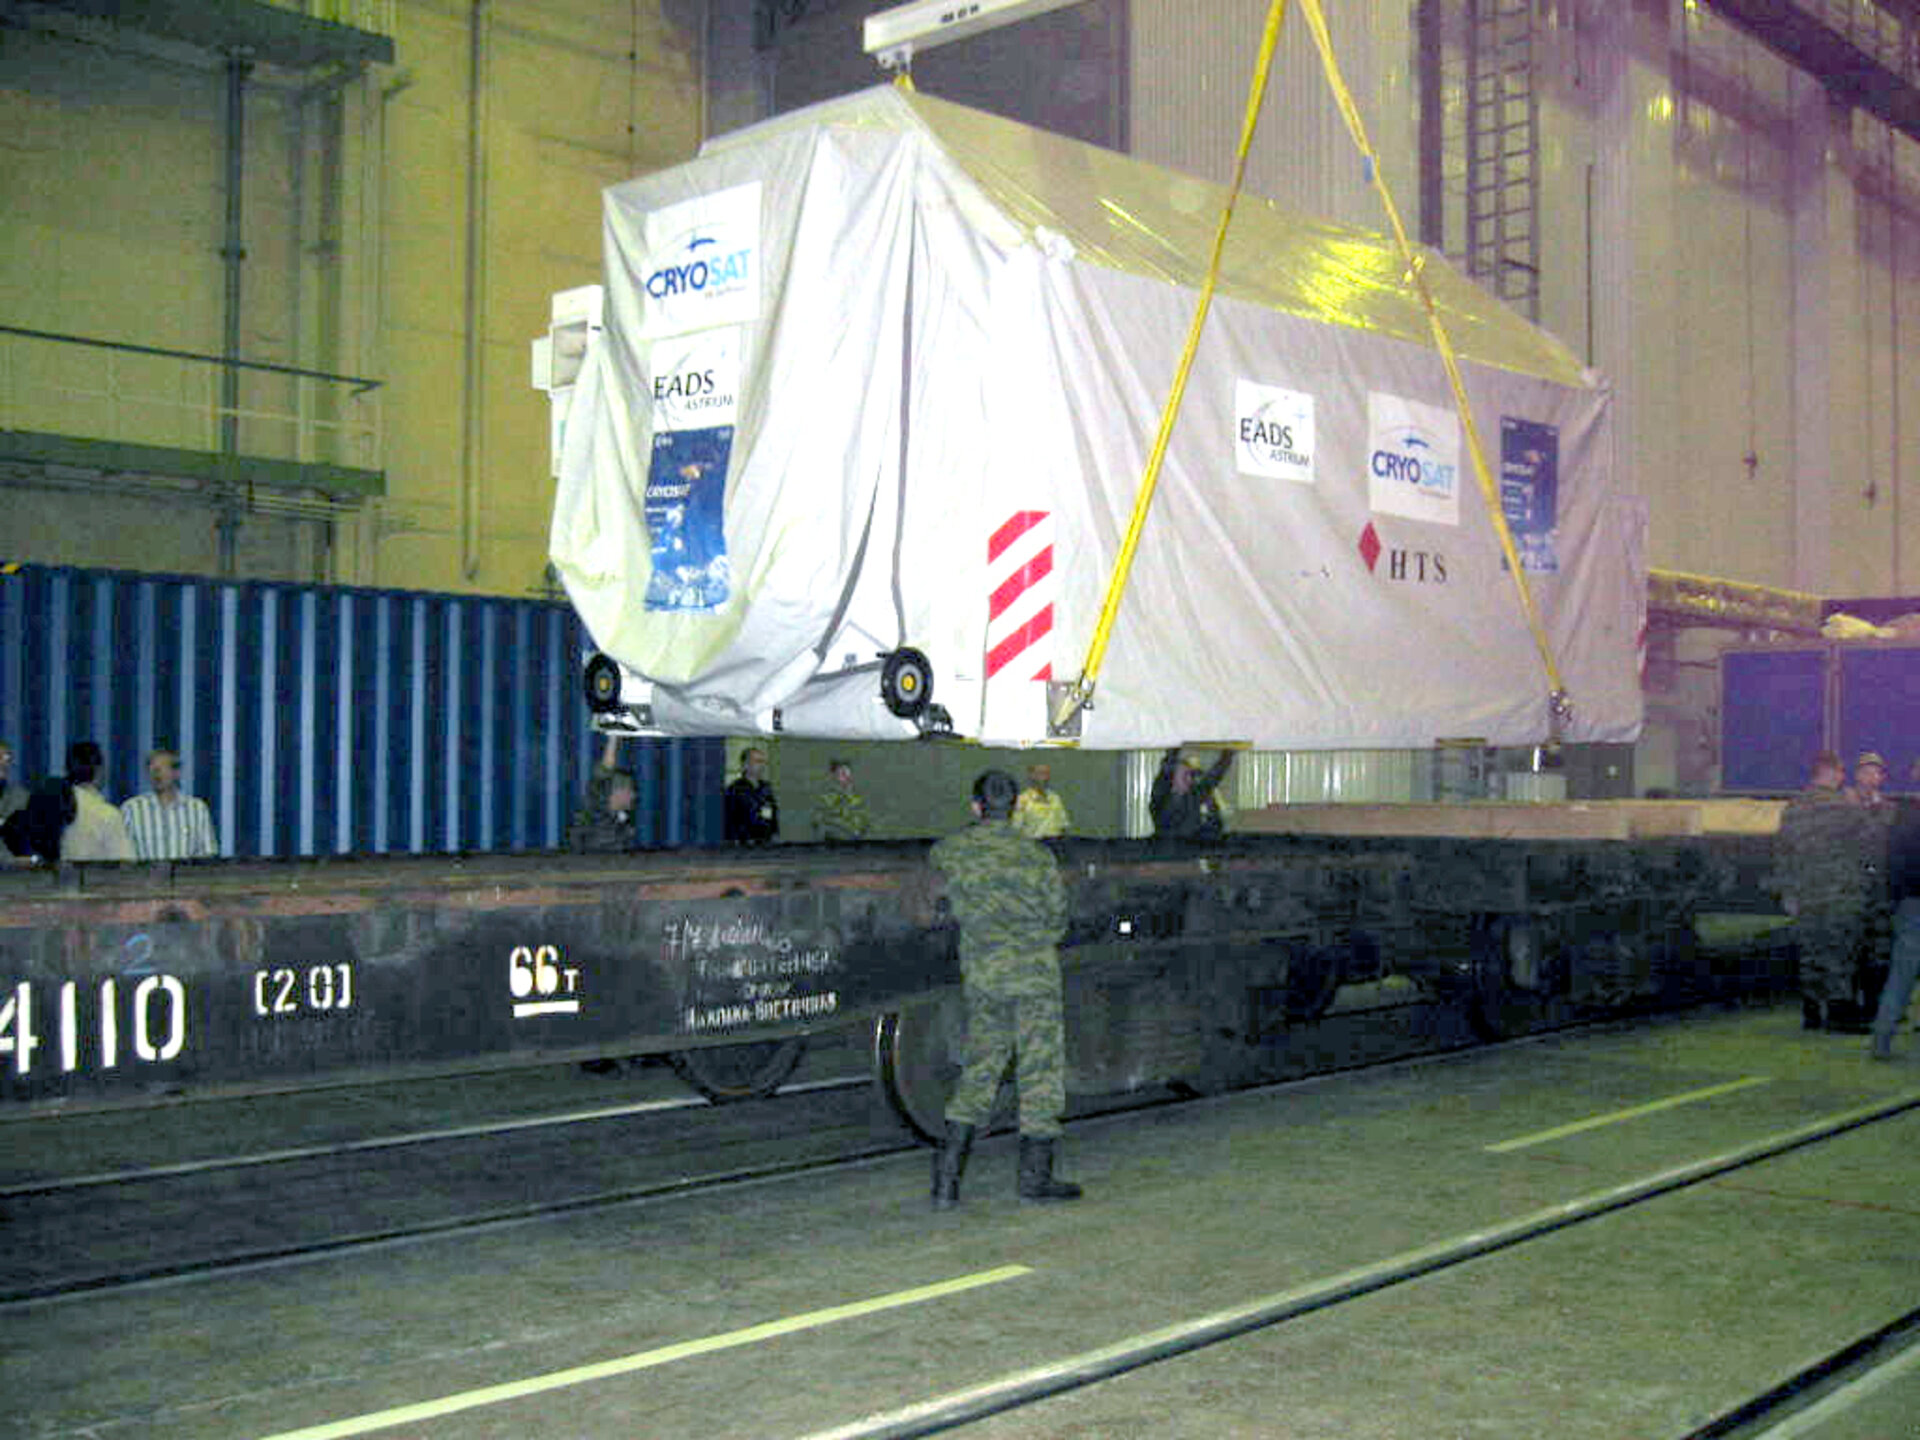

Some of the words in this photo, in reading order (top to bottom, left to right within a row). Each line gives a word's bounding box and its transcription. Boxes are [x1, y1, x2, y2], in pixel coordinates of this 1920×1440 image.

[646, 249, 752, 299] CRYOSAT
[654, 369, 715, 401] EADS
[1240, 417, 1294, 449] EADS
[1269, 449, 1310, 468] ASTRIUM
[1371, 450, 1456, 489] CRYOSAT
[1389, 550, 1448, 583] HTS
